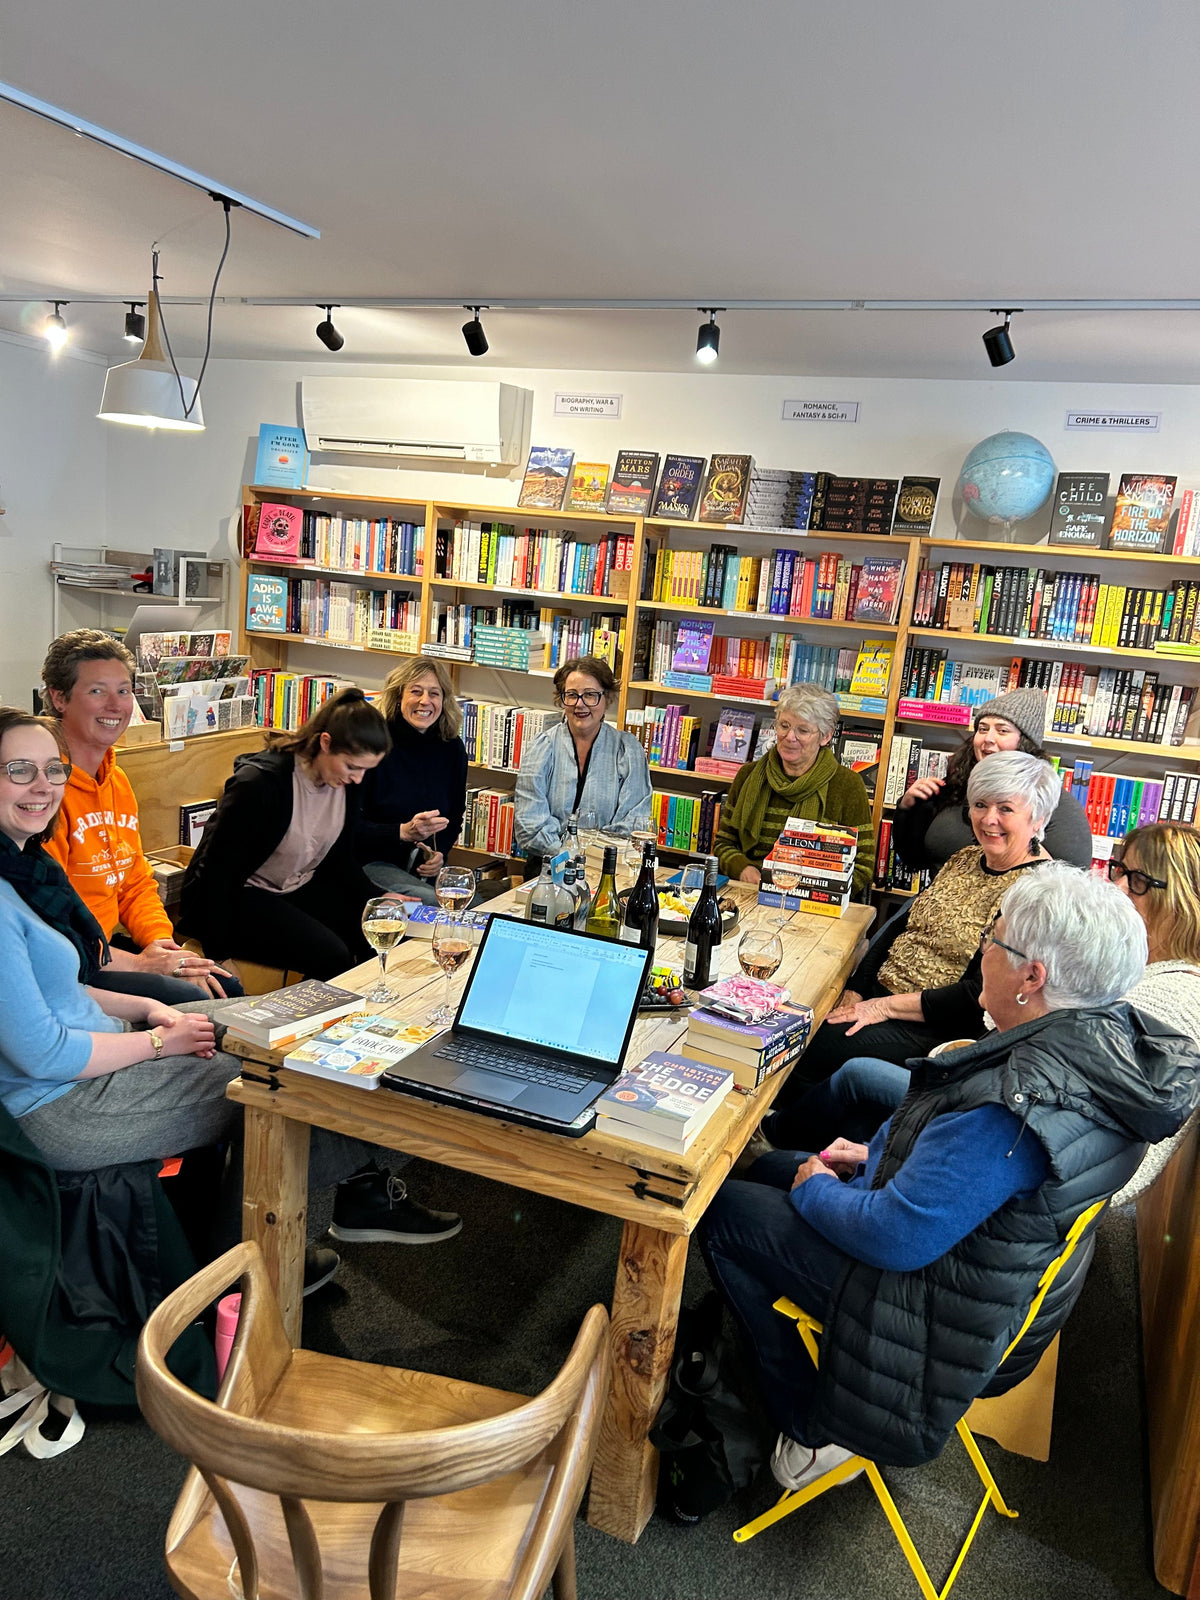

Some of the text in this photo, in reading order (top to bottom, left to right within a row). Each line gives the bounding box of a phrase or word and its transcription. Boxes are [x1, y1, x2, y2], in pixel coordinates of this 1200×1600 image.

[561, 397, 595, 406] BIOGRAPHY,
[803, 403, 838, 411] ROMANCE,
[620, 464, 651, 474] MARS
[677, 462, 691, 470] The
[668, 468, 695, 479] ORDER
[1070, 482, 1095, 491] LEE
[901, 495, 933, 505] FOURTH
[1060, 492, 1103, 502] CHILD
[658, 501, 689, 515] MASKS
[900, 503, 931, 516] WING
[1121, 505, 1163, 519] FIRE ON
[1066, 524, 1088, 532] SAFE
[1130, 518, 1148, 530] THE
[1059, 530, 1095, 539] ENOUGH
[1113, 530, 1161, 544] HORIZON
[616, 537, 625, 571] LEBRO
[625, 537, 634, 571] LEBRO
[774, 560, 783, 588] HUSBANDS
[782, 561, 791, 588] HUSBANDS
[994, 572, 1003, 592] SHOT
[252, 583, 283, 595] ADHD
[867, 586, 883, 594] WAS
[1026, 583, 1034, 603] CLANCY
[262, 593, 272, 603] IS
[1174, 585, 1185, 619] ARGYLLE
[1185, 586, 1196, 620] ARGYLLE
[255, 604, 279, 614] AWE
[251, 613, 282, 625] SOME
[680, 620, 712, 629] NOTHING
[677, 648, 707, 656] MOVIES
[864, 656, 886, 664] THAN
[865, 666, 880, 674] THE
[944, 662, 953, 687] FITZEK
[953, 662, 962, 687] FITZEK
[965, 671, 995, 680] FITZEK
[854, 676, 886, 685] MOVIES
[1000, 669, 1009, 693] FITZEK
[887, 775, 895, 795] NERO
[896, 776, 905, 796] NERO
[789, 838, 816, 849] LEON
[799, 876, 829, 887] LACKWATER
[638, 1061, 676, 1076] THE
[663, 1061, 723, 1082] CHRISTIAN
[683, 1072, 720, 1086] WHITE
[636, 1070, 714, 1101] LEDGE
